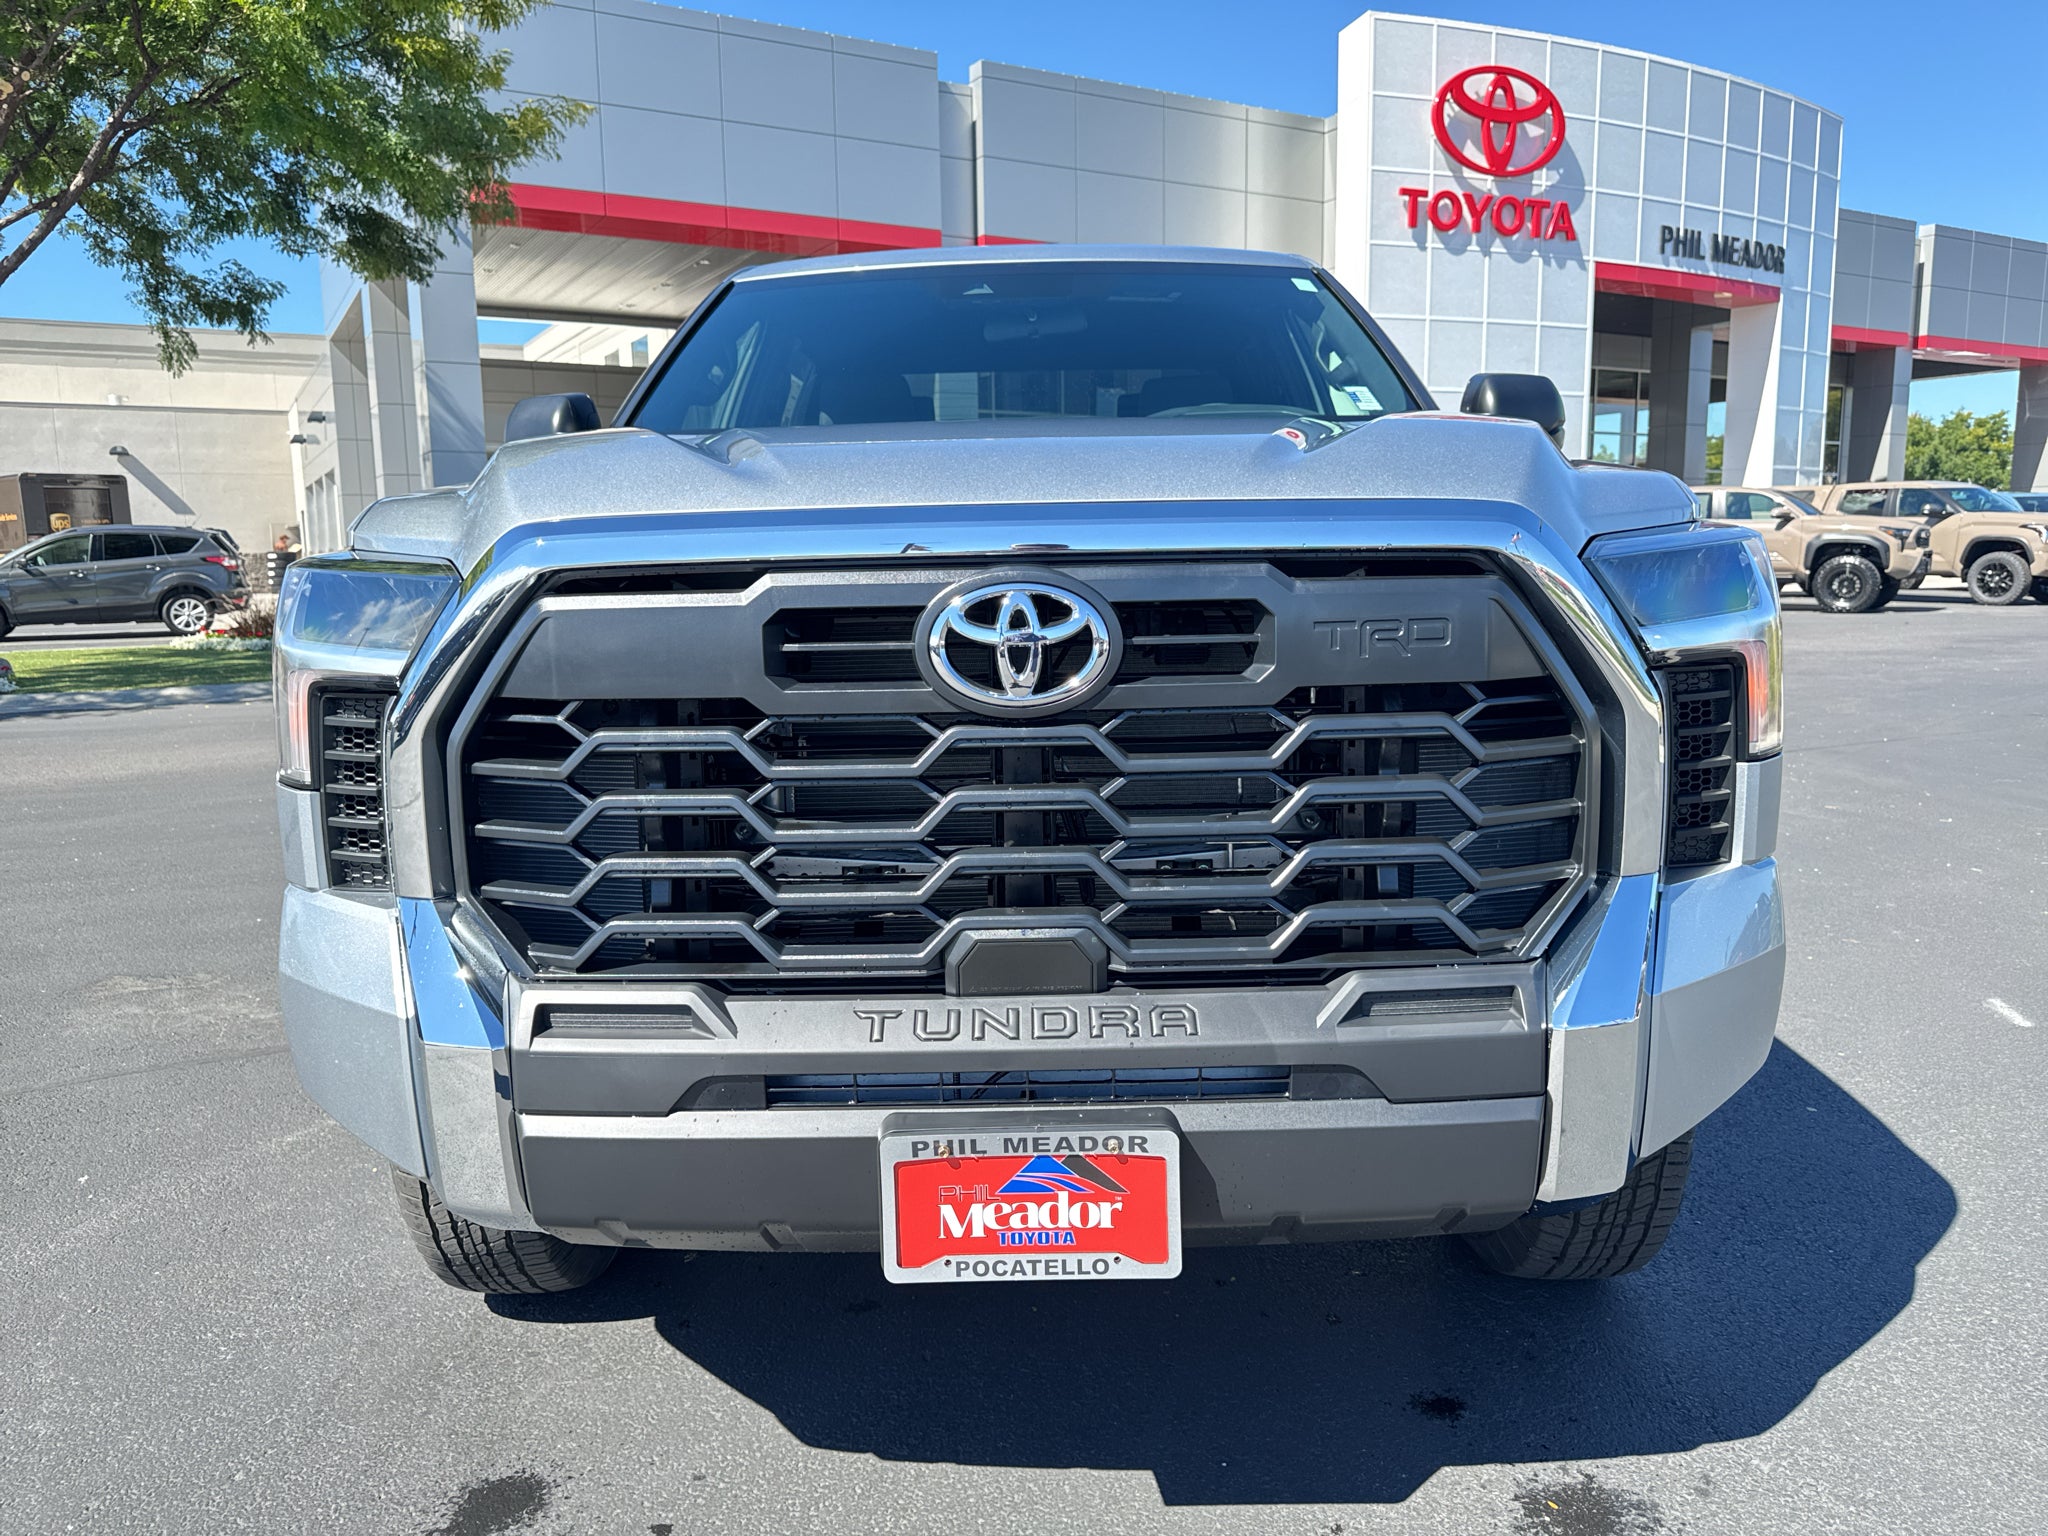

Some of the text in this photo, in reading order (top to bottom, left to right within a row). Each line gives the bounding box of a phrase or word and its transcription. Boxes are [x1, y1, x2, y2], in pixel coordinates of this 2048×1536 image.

[1399, 187, 1577, 241] TOYOTA
[1660, 225, 1786, 274] PHIL MEADOR
[1313, 617, 1452, 658] TRD
[853, 1003, 1200, 1043] TUNDRA
[912, 1135, 1149, 1158] PHIL MEADOR
[938, 1184, 1001, 1202] PHIL
[937, 1190, 1123, 1239] Meador
[997, 1230, 1076, 1246] TOYOTA
[955, 1258, 1110, 1278] POCATELLO
